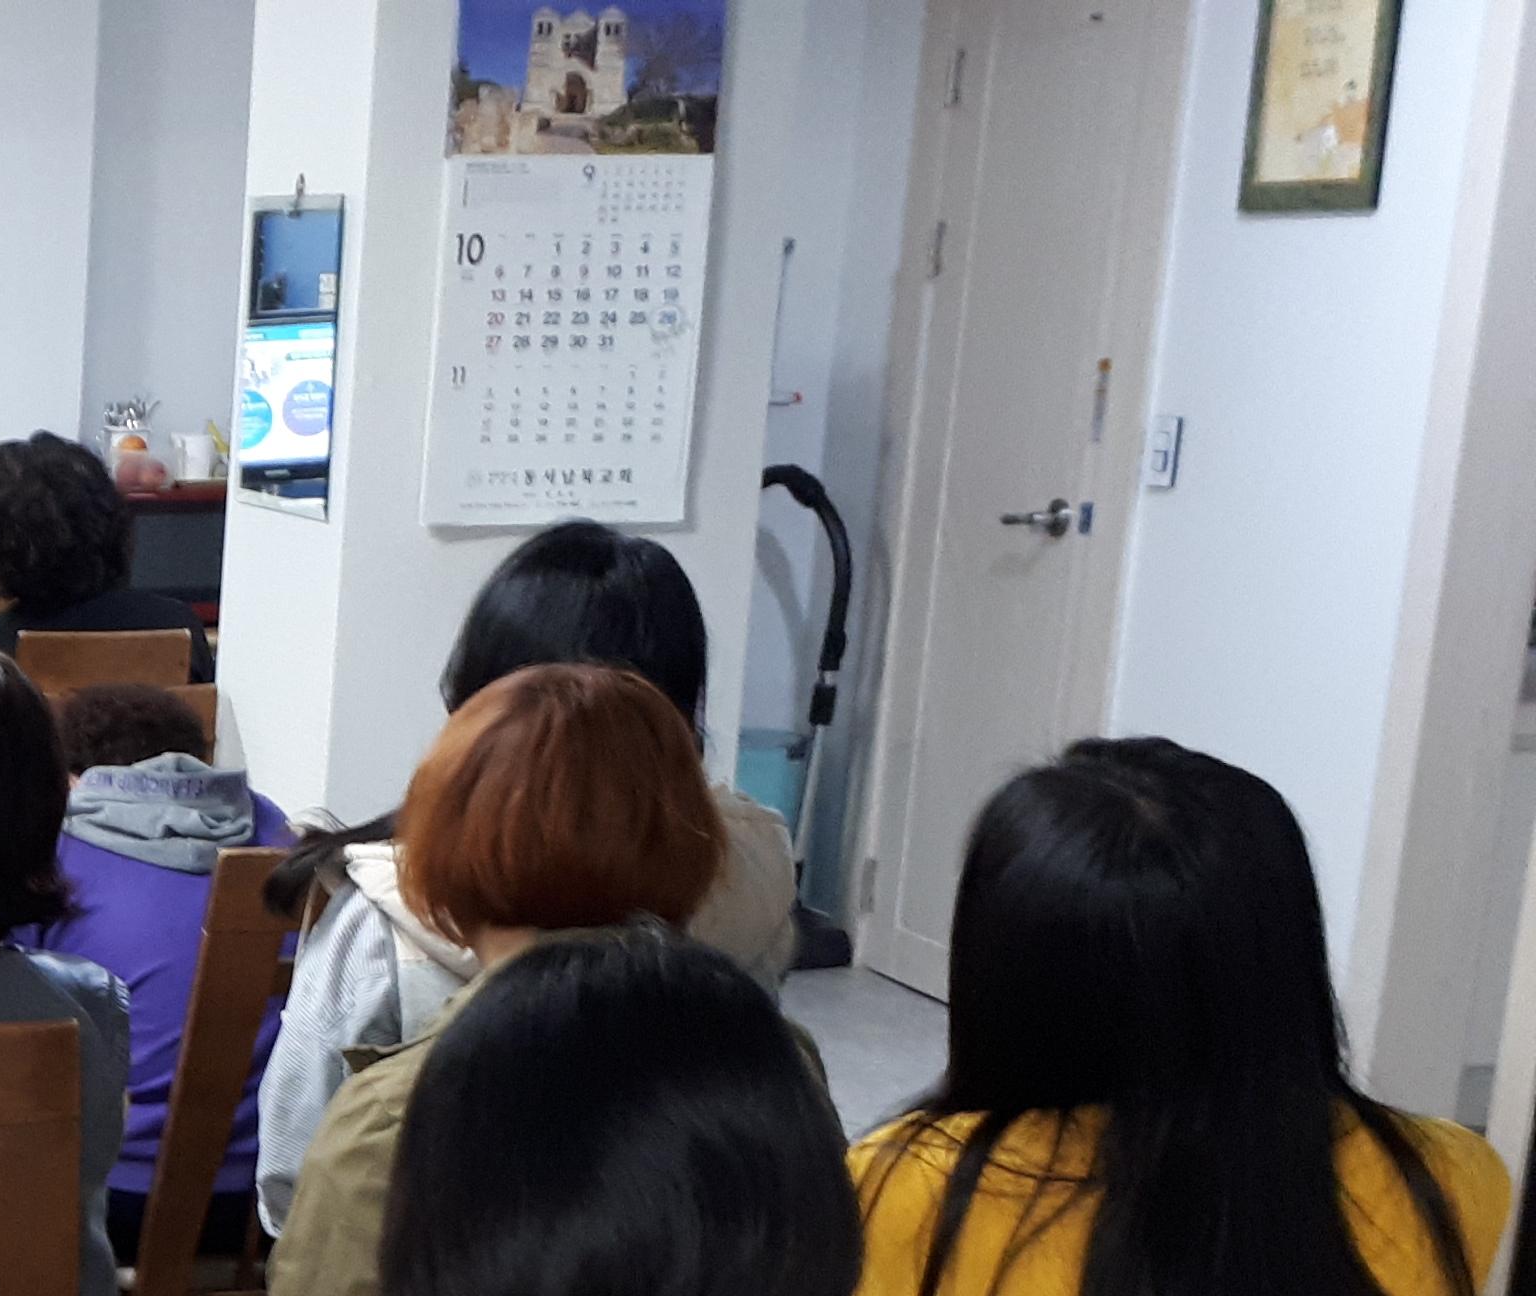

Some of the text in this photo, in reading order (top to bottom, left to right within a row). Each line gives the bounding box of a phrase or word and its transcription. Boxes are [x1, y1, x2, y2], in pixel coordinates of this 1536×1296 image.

[456, 233, 485, 265] 10
[582, 241, 591, 254] 2
[607, 265, 622, 278] 10
[636, 265, 649, 278] 11
[665, 265, 681, 278] 12
[491, 289, 506, 301] 13
[519, 289, 533, 301] 14
[547, 289, 562, 301] 15
[604, 289, 619, 300] 17
[634, 288, 648, 301] 18
[487, 312, 505, 325] 20
[515, 312, 530, 325] 21
[543, 312, 561, 325] 22
[571, 312, 590, 325] 23
[599, 312, 617, 325] 24
[629, 312, 646, 325] 25
[485, 336, 614, 349] 27 28 29 30 31
